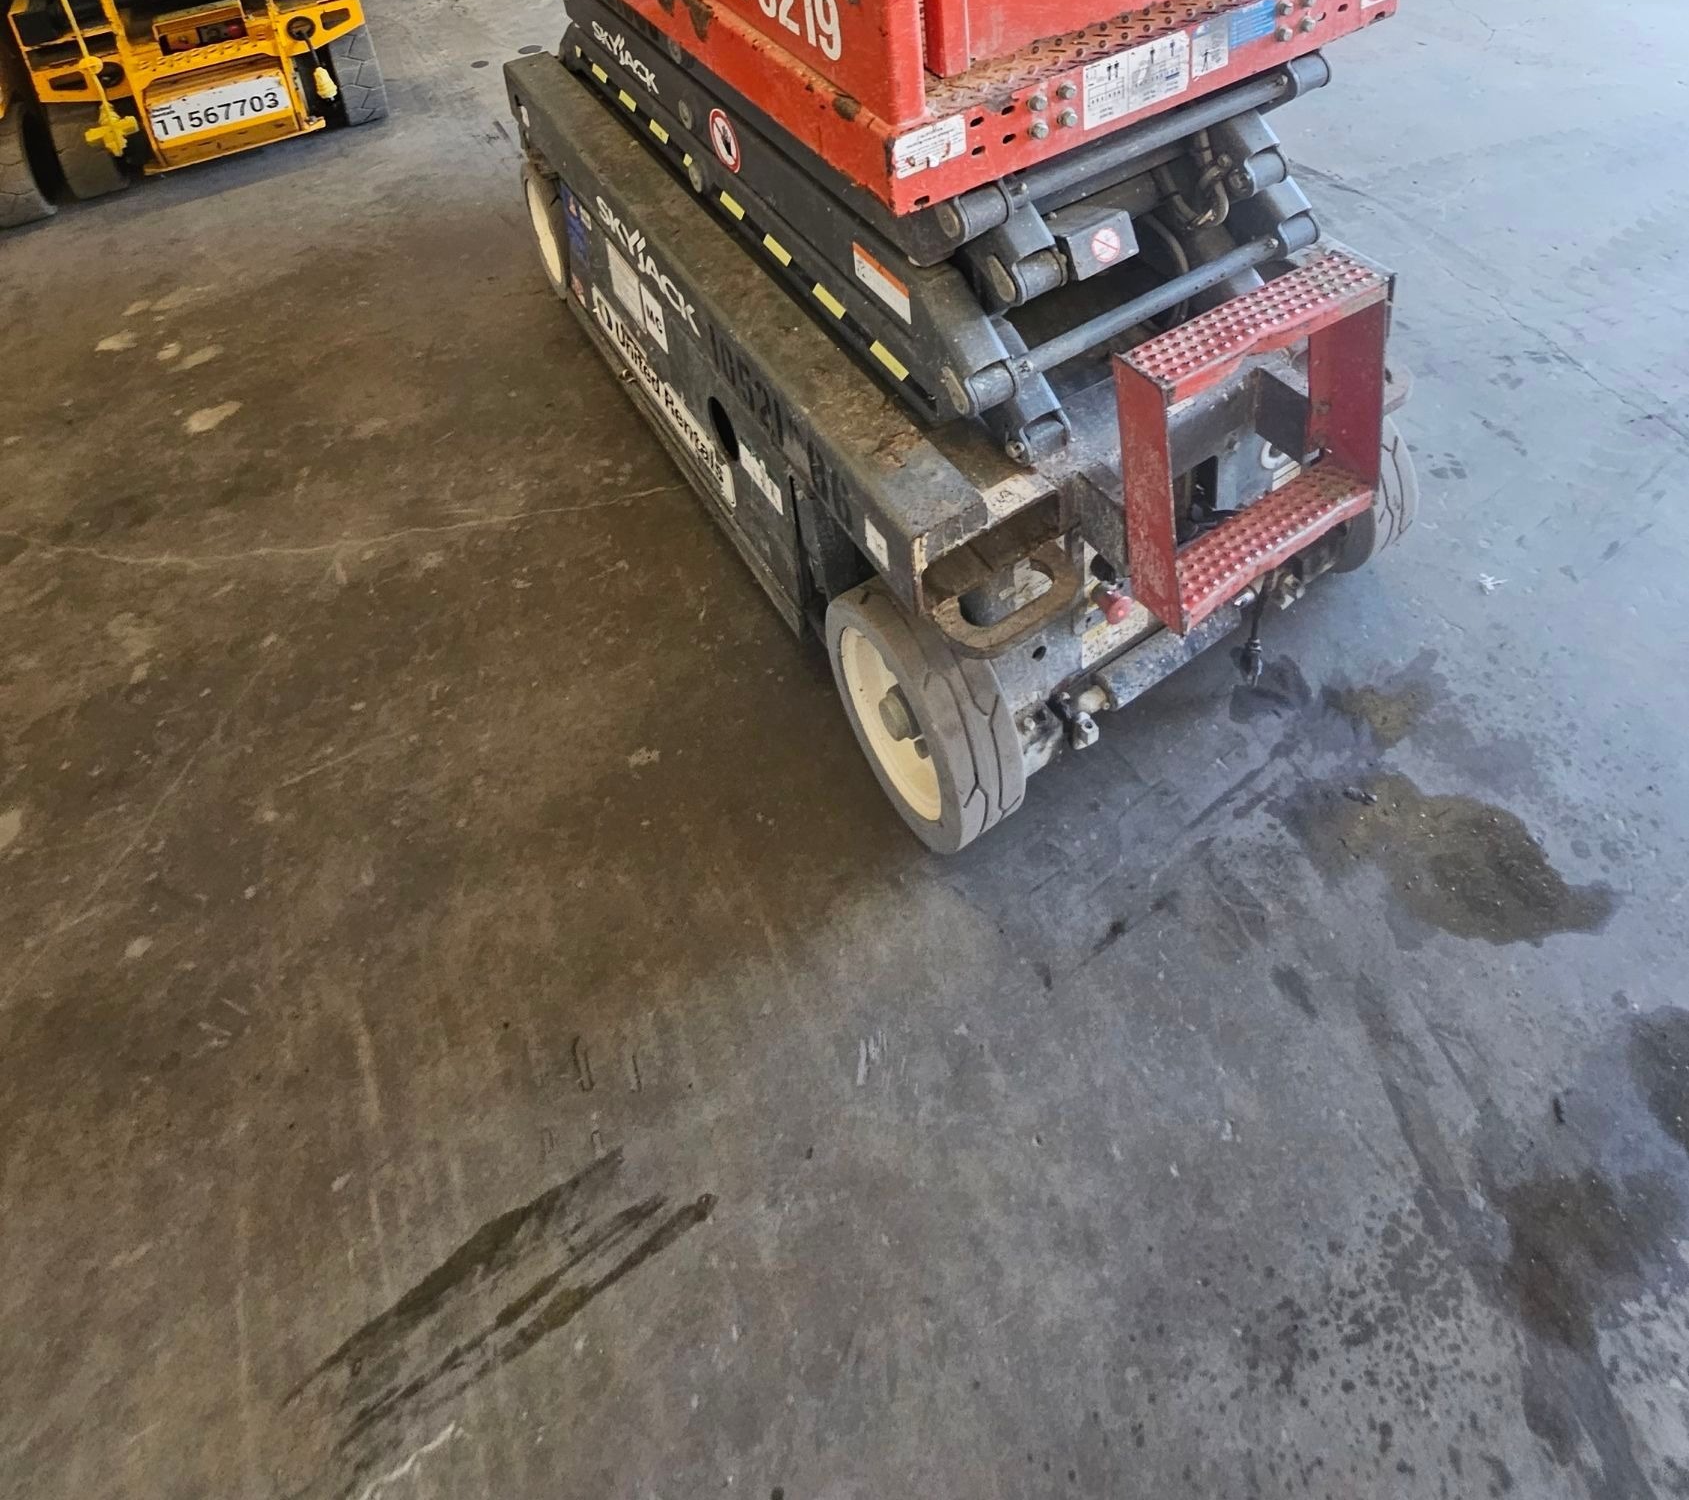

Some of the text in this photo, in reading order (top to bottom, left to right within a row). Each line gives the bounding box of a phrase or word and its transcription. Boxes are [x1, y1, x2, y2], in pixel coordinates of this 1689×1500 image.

[592, 20, 659, 95] SKYJACK
[155, 91, 280, 136] 11567703
[596, 196, 701, 338] SKYJACK
[615, 321, 725, 484] United Rentals
